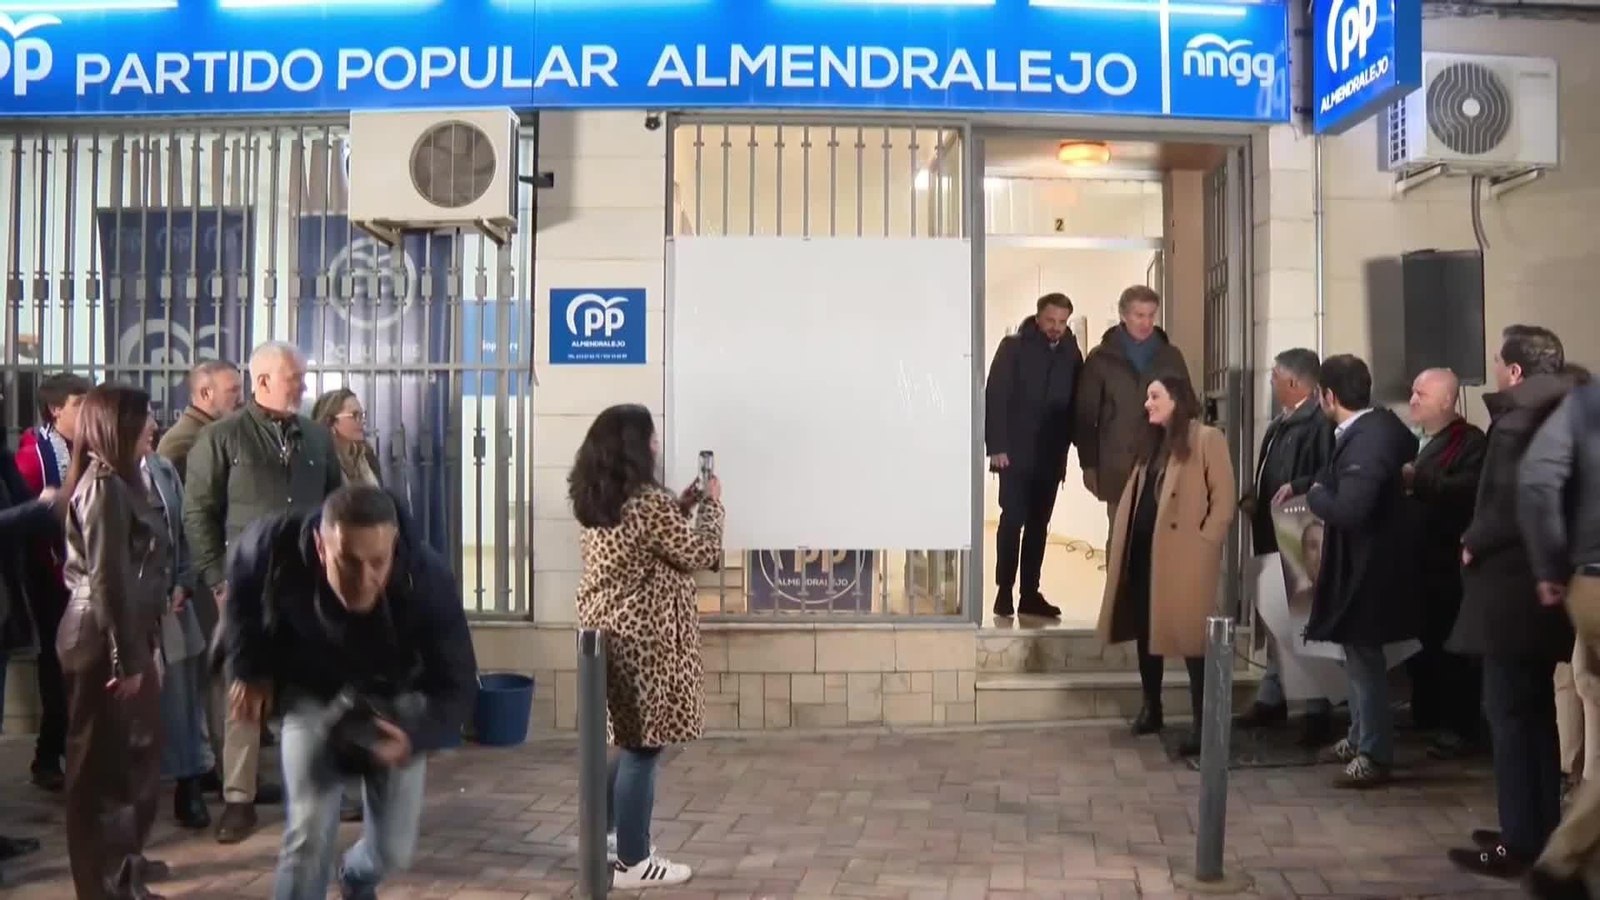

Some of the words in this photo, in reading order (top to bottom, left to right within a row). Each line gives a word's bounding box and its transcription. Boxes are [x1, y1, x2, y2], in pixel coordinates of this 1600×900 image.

[0, 37, 53, 96] p
[76, 49, 323, 95] PARTIDO
[338, 45, 618, 90] POPULAR
[647, 44, 1137, 96] ALMENDRALEJO
[1183, 49, 1275, 87] nngg
[1320, 58, 1389, 113] ALMENDRALEJO
[1055, 218, 1065, 231] 2
[584, 307, 625, 337] pp
[571, 340, 626, 348] ALMENDRALEJO
